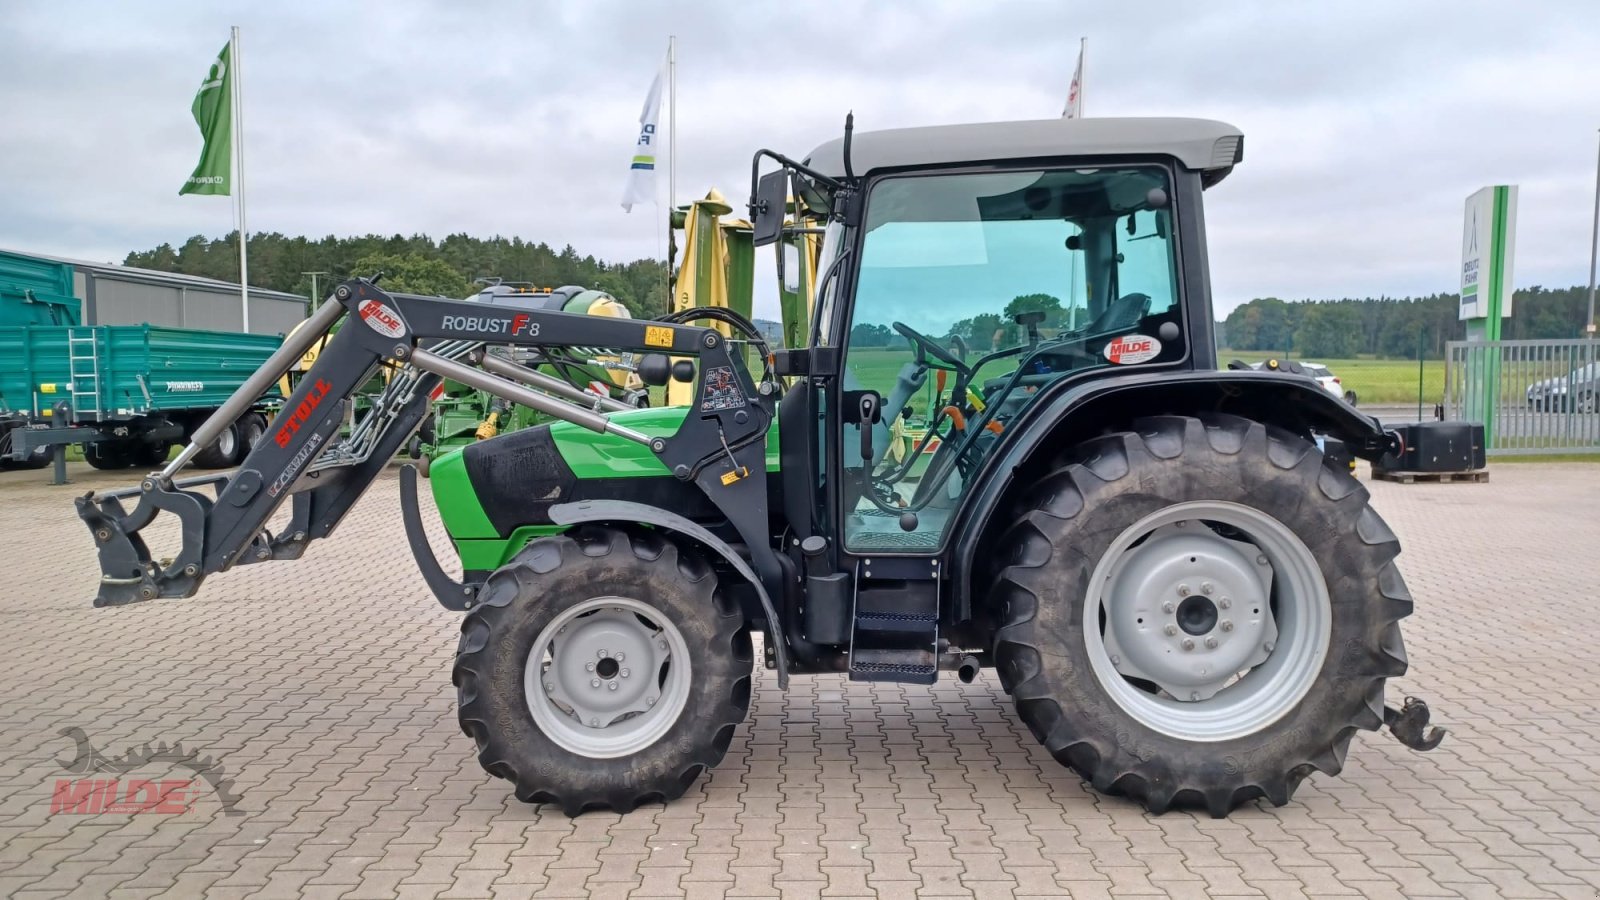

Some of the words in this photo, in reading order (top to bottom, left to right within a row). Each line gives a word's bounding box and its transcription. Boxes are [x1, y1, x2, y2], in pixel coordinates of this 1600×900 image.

[1464, 258, 1479, 272] DEUTZ
[1465, 271, 1478, 285] FAHR
[363, 302, 400, 330] MILDE
[441, 315, 511, 333] ROBUST
[529, 323, 540, 336] 8
[1110, 341, 1151, 355] MILDE
[274, 378, 333, 449] STOLL
